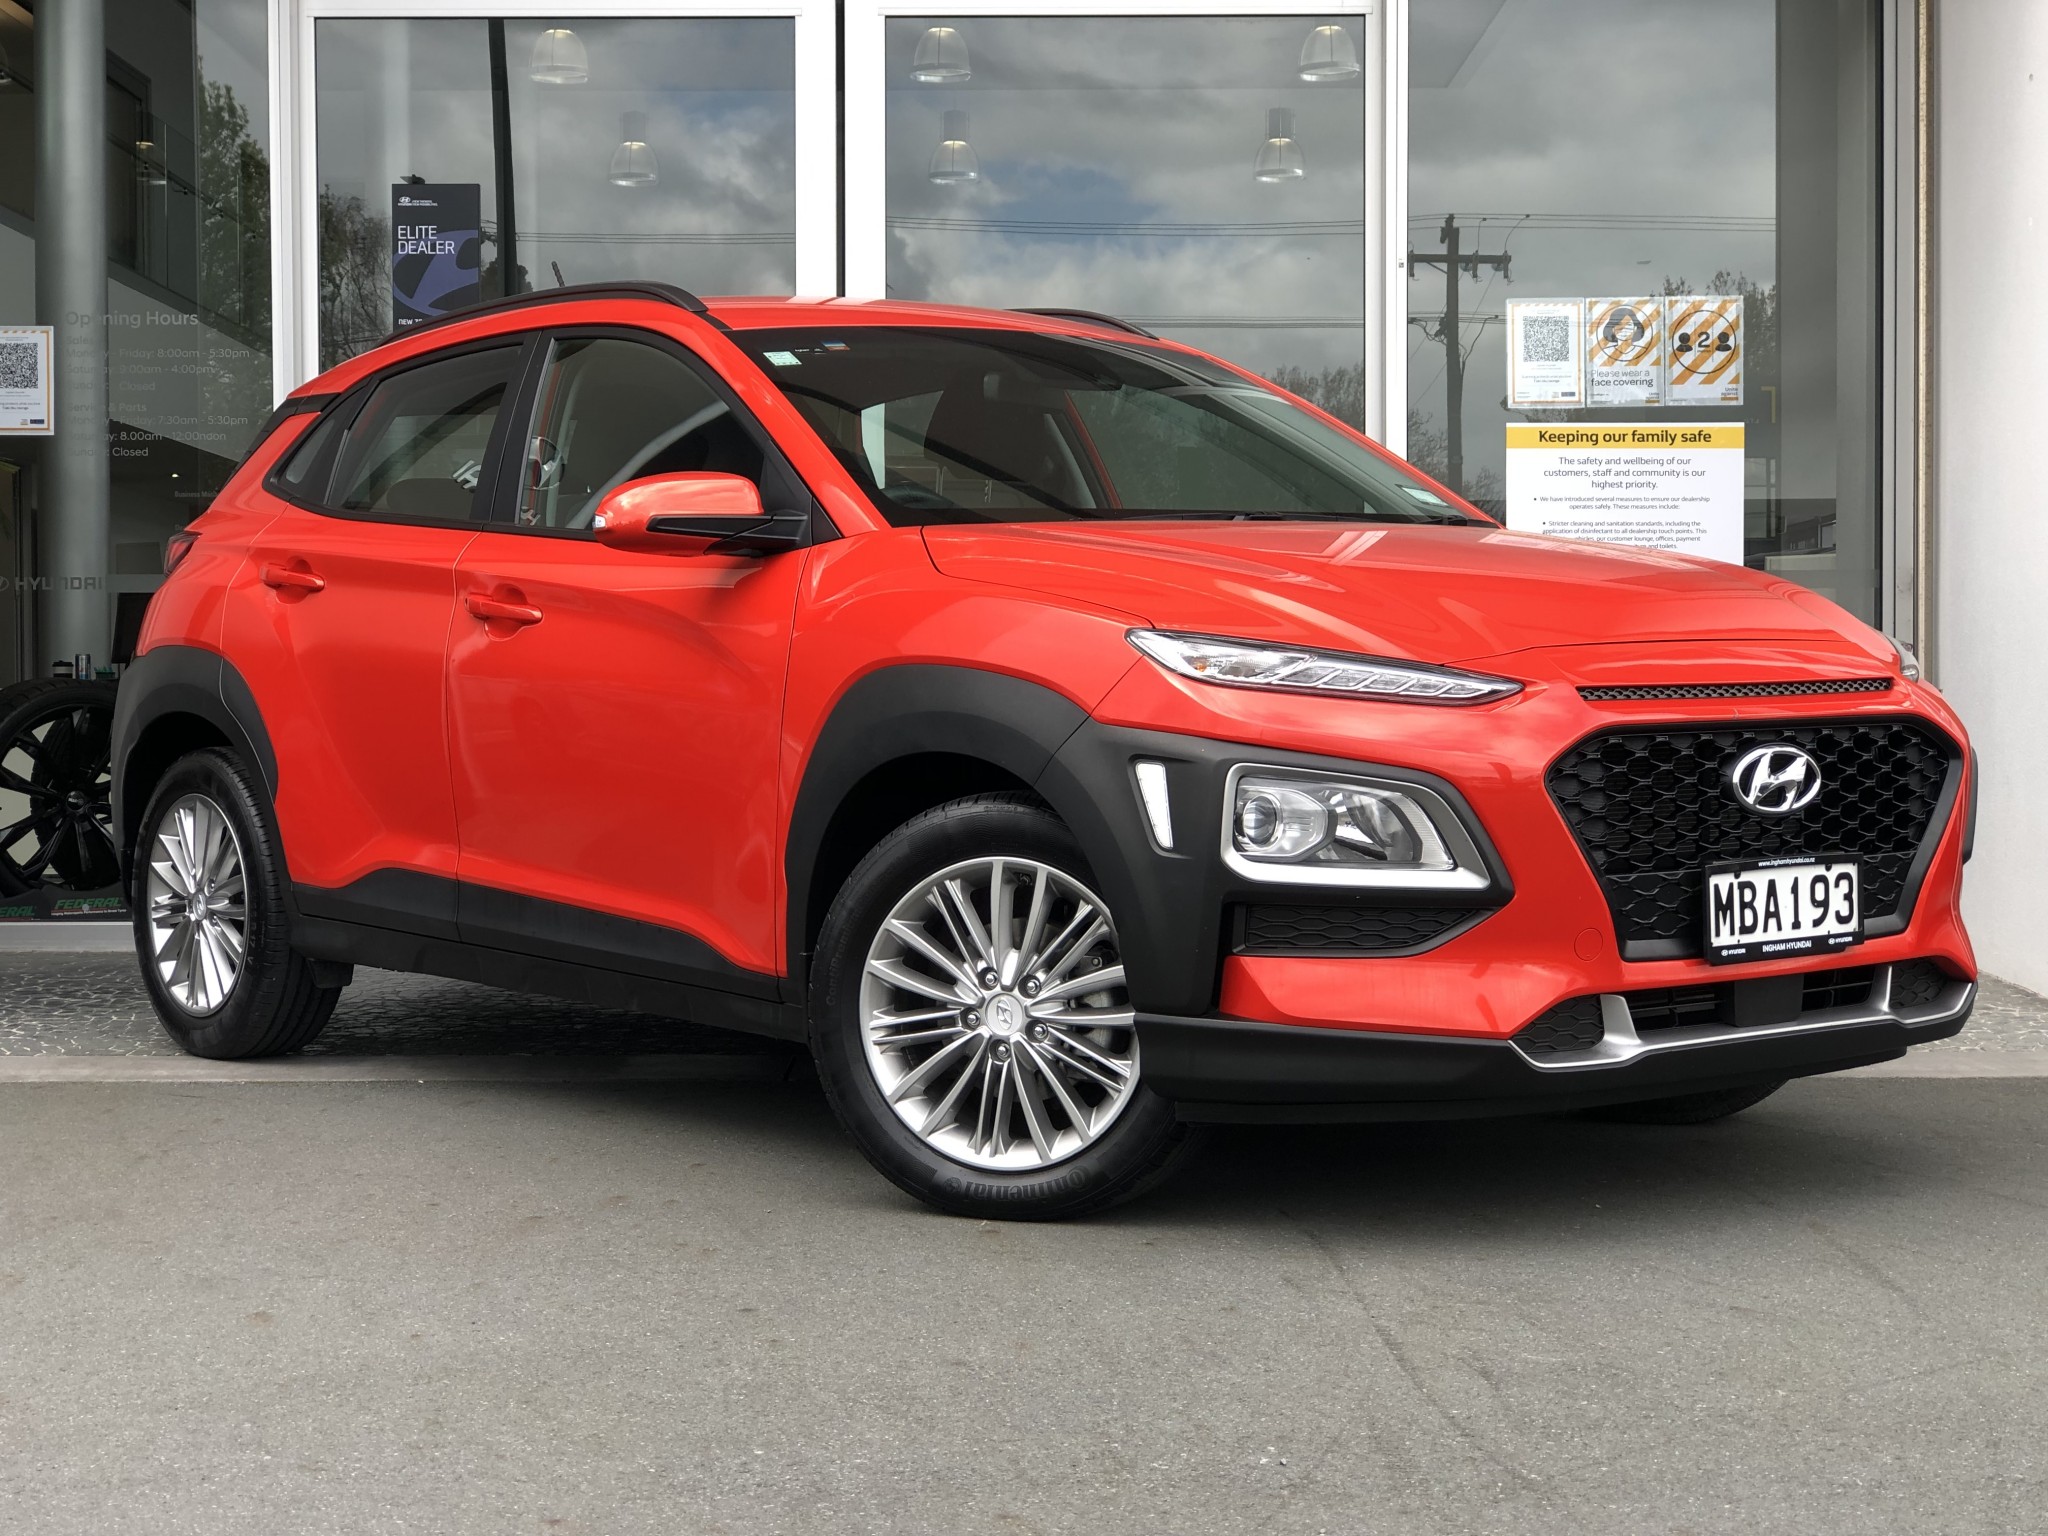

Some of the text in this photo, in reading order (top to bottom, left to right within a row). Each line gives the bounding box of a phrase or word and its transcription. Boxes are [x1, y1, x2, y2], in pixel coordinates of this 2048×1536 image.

[398, 226, 437, 239] ELITE
[398, 241, 455, 254] DEALER
[66, 310, 198, 328] Opning Hours
[65, 335, 93, 346] Sale
[1698, 331, 1710, 348] 2
[157, 348, 199, 358] 8:00am
[209, 348, 250, 360] 5:30pm
[1613, 379, 1654, 387] covering
[207, 415, 248, 427] 5:30pm
[1539, 430, 1711, 446] Keeping our family safe
[112, 447, 149, 457] Closed
[1558, 457, 1575, 465] The
[1577, 457, 1603, 467] safety
[1605, 457, 1621, 465] and
[1623, 457, 1664, 467] wellbeing
[1666, 457, 1675, 465] of
[1544, 468, 1591, 478] customers,
[1593, 468, 1612, 477] staff
[1614, 468, 1630, 477] and
[1632, 468, 1681, 479] community
[1683, 468, 1690, 477] is
[1592, 480, 1658, 491] highest priority.
[1595, 503, 1612, 511] safely.
[1570, 520, 1593, 528] cleaning
[1665, 520, 1690, 528] including
[1676, 536, 1700, 544] payment
[1758, 857, 1815, 867] www.inghamhyundai.co.nz
[55, 897, 121, 909] FEDERAL
[1714, 872, 1854, 937] MBA193
[0, 905, 35, 917] ERAL
[1835, 936, 1852, 944] HYUNDAI
[1763, 940, 1812, 953] INGHAM HYUNDAI
